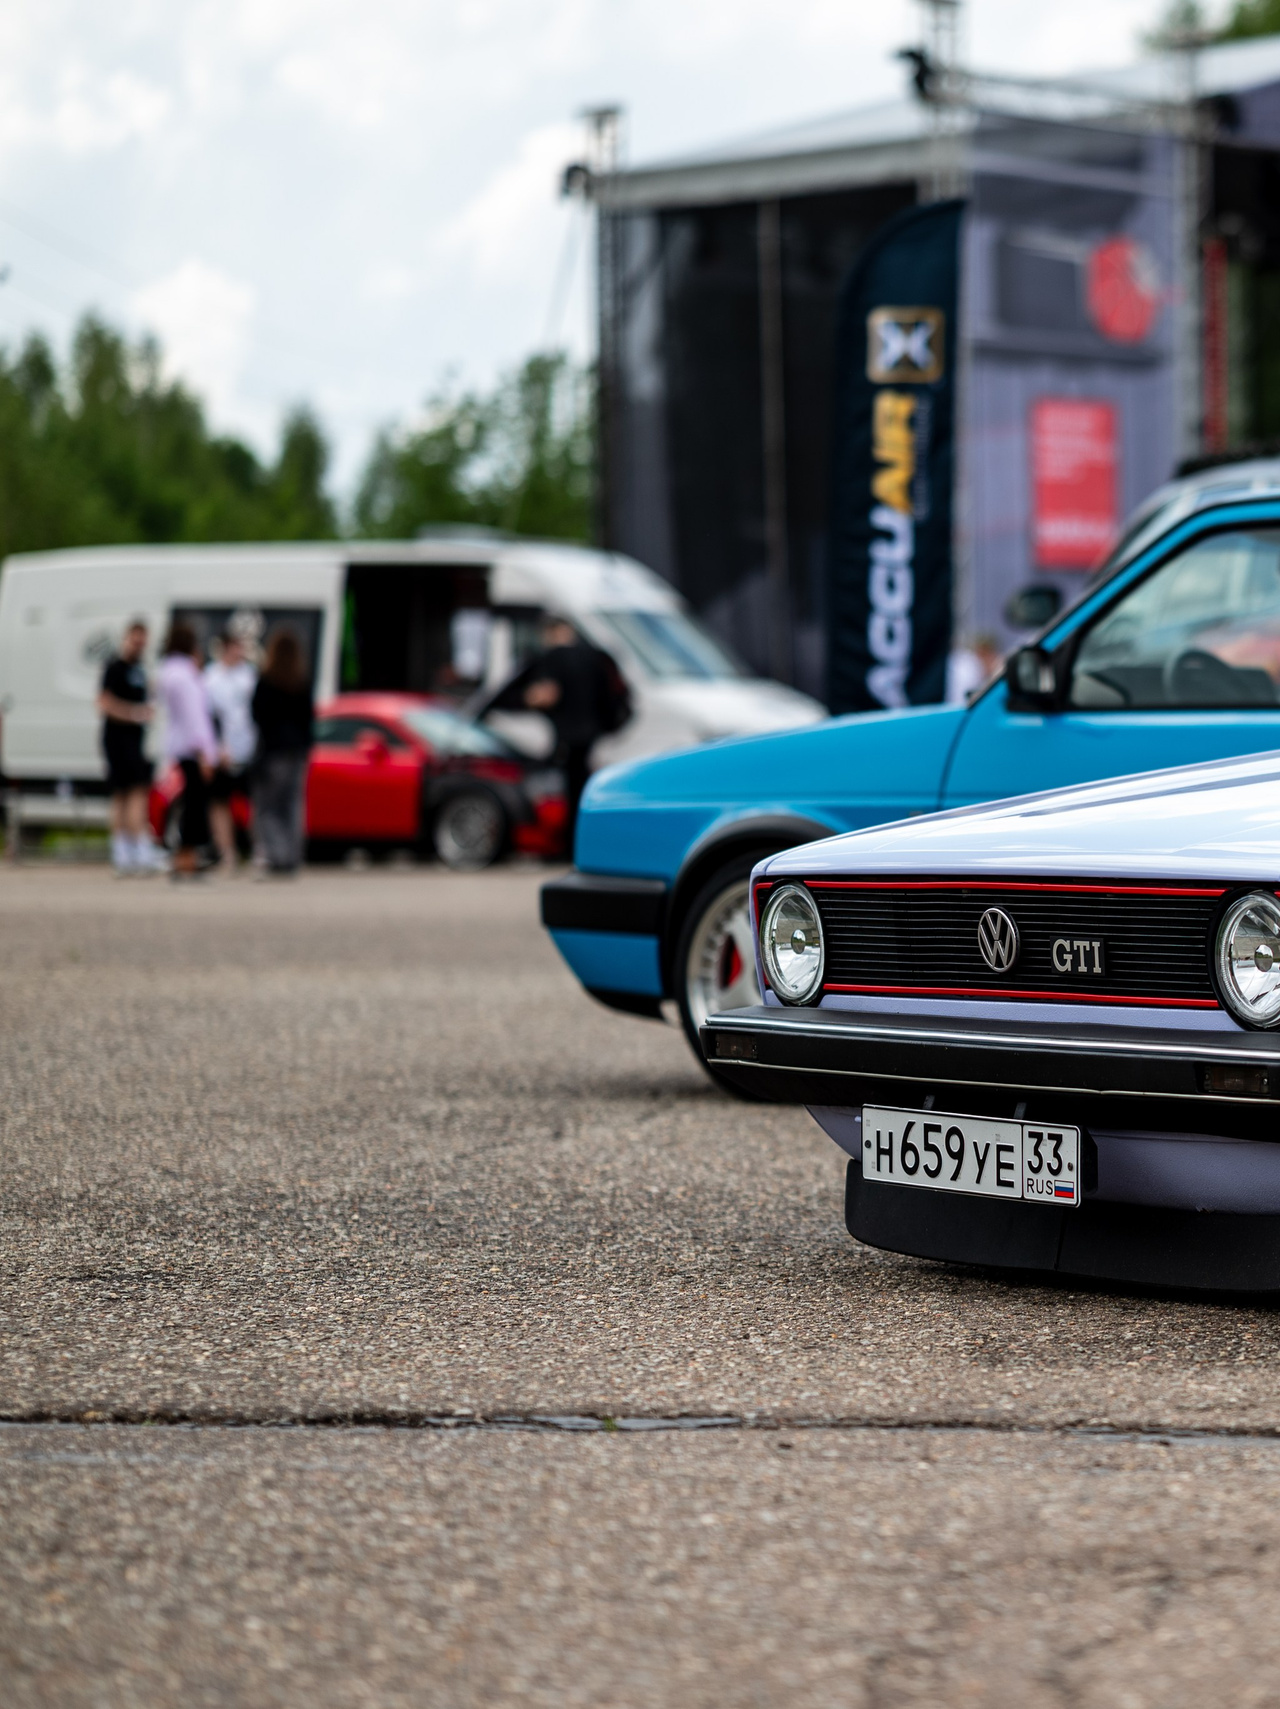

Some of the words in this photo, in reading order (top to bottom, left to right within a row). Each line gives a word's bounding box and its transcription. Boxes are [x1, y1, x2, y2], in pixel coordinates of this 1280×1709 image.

[1052, 938, 1102, 974] GTI
[1027, 1131, 1063, 1176] 33
[1027, 1178, 1053, 1196] RUS
